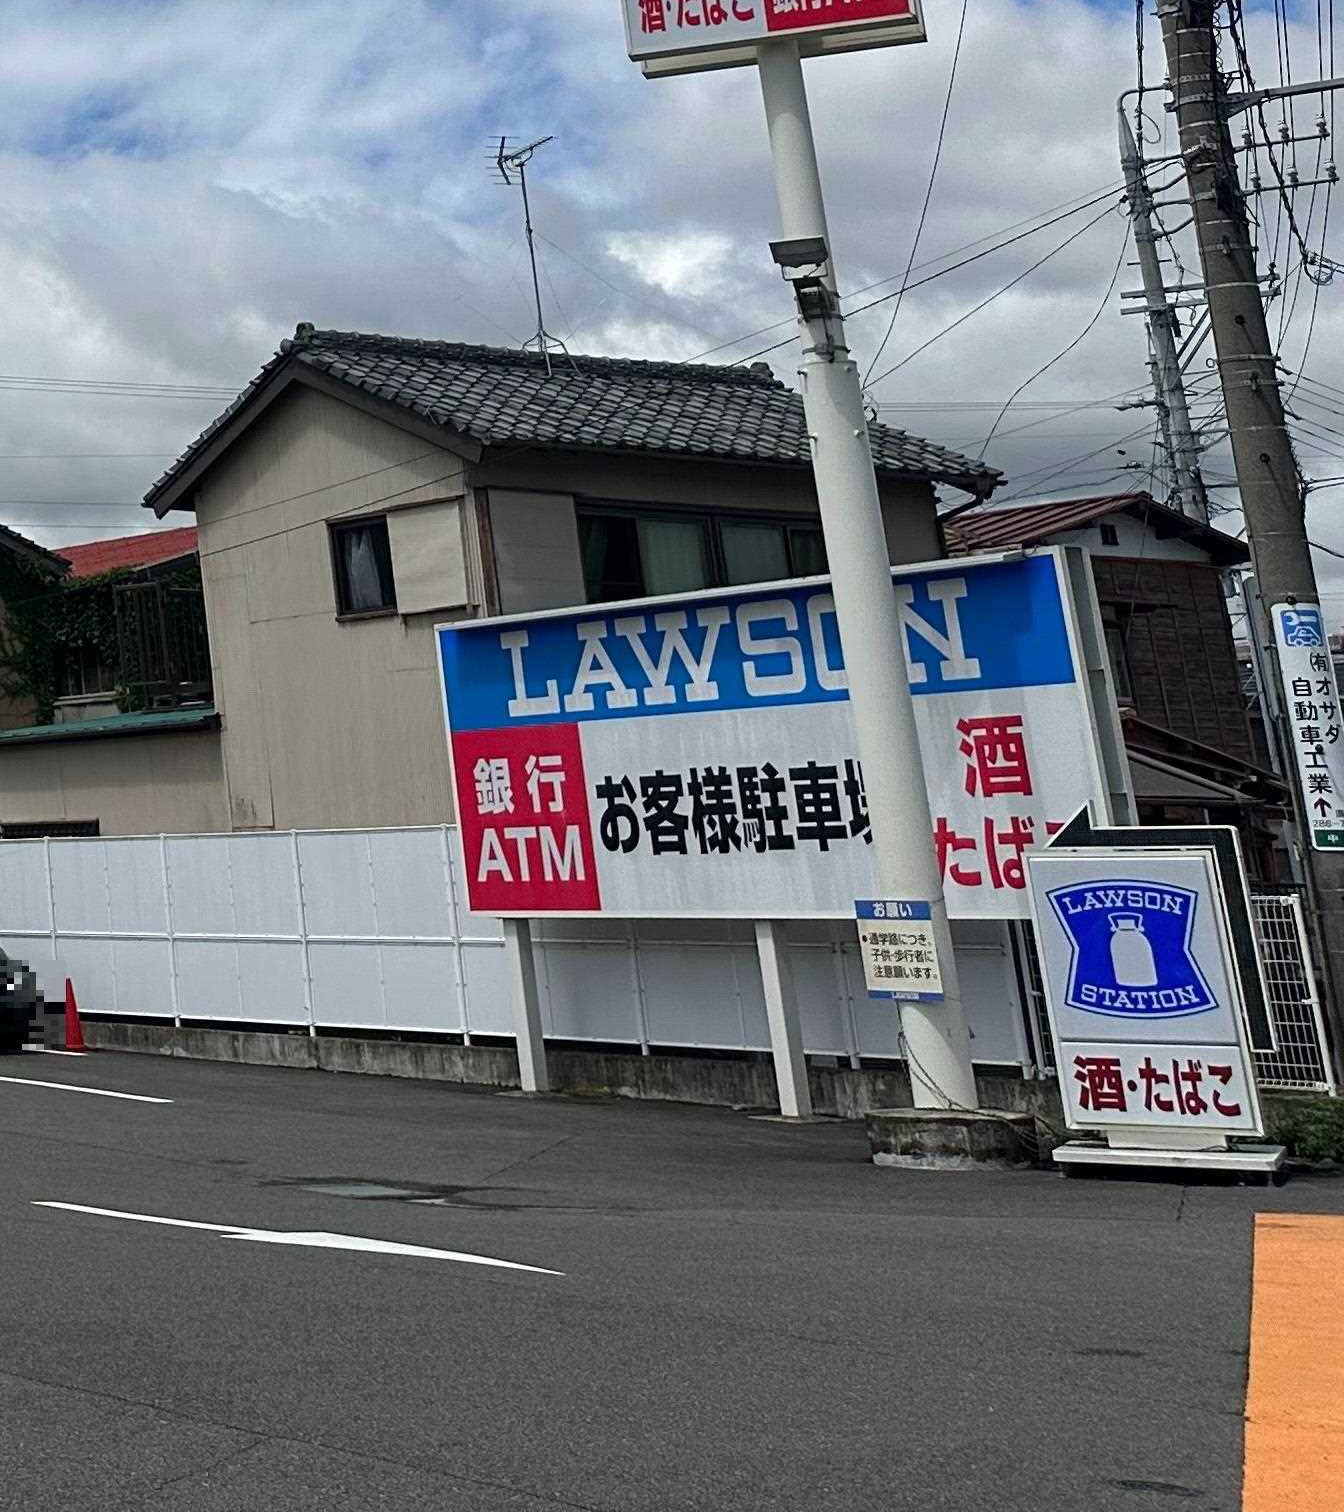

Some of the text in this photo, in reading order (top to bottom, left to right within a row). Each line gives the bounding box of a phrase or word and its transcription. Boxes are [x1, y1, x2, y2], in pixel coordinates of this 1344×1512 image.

[956, 715, 1033, 798] 酒
[1292, 677, 1333, 794] 自動車工業
[473, 754, 567, 815] 銀行
[478, 825, 586, 883] ATM
[934, 816, 1066, 889] たば
[1063, 890, 1184, 915] LAWSON
[1081, 984, 1199, 1008] STATION
